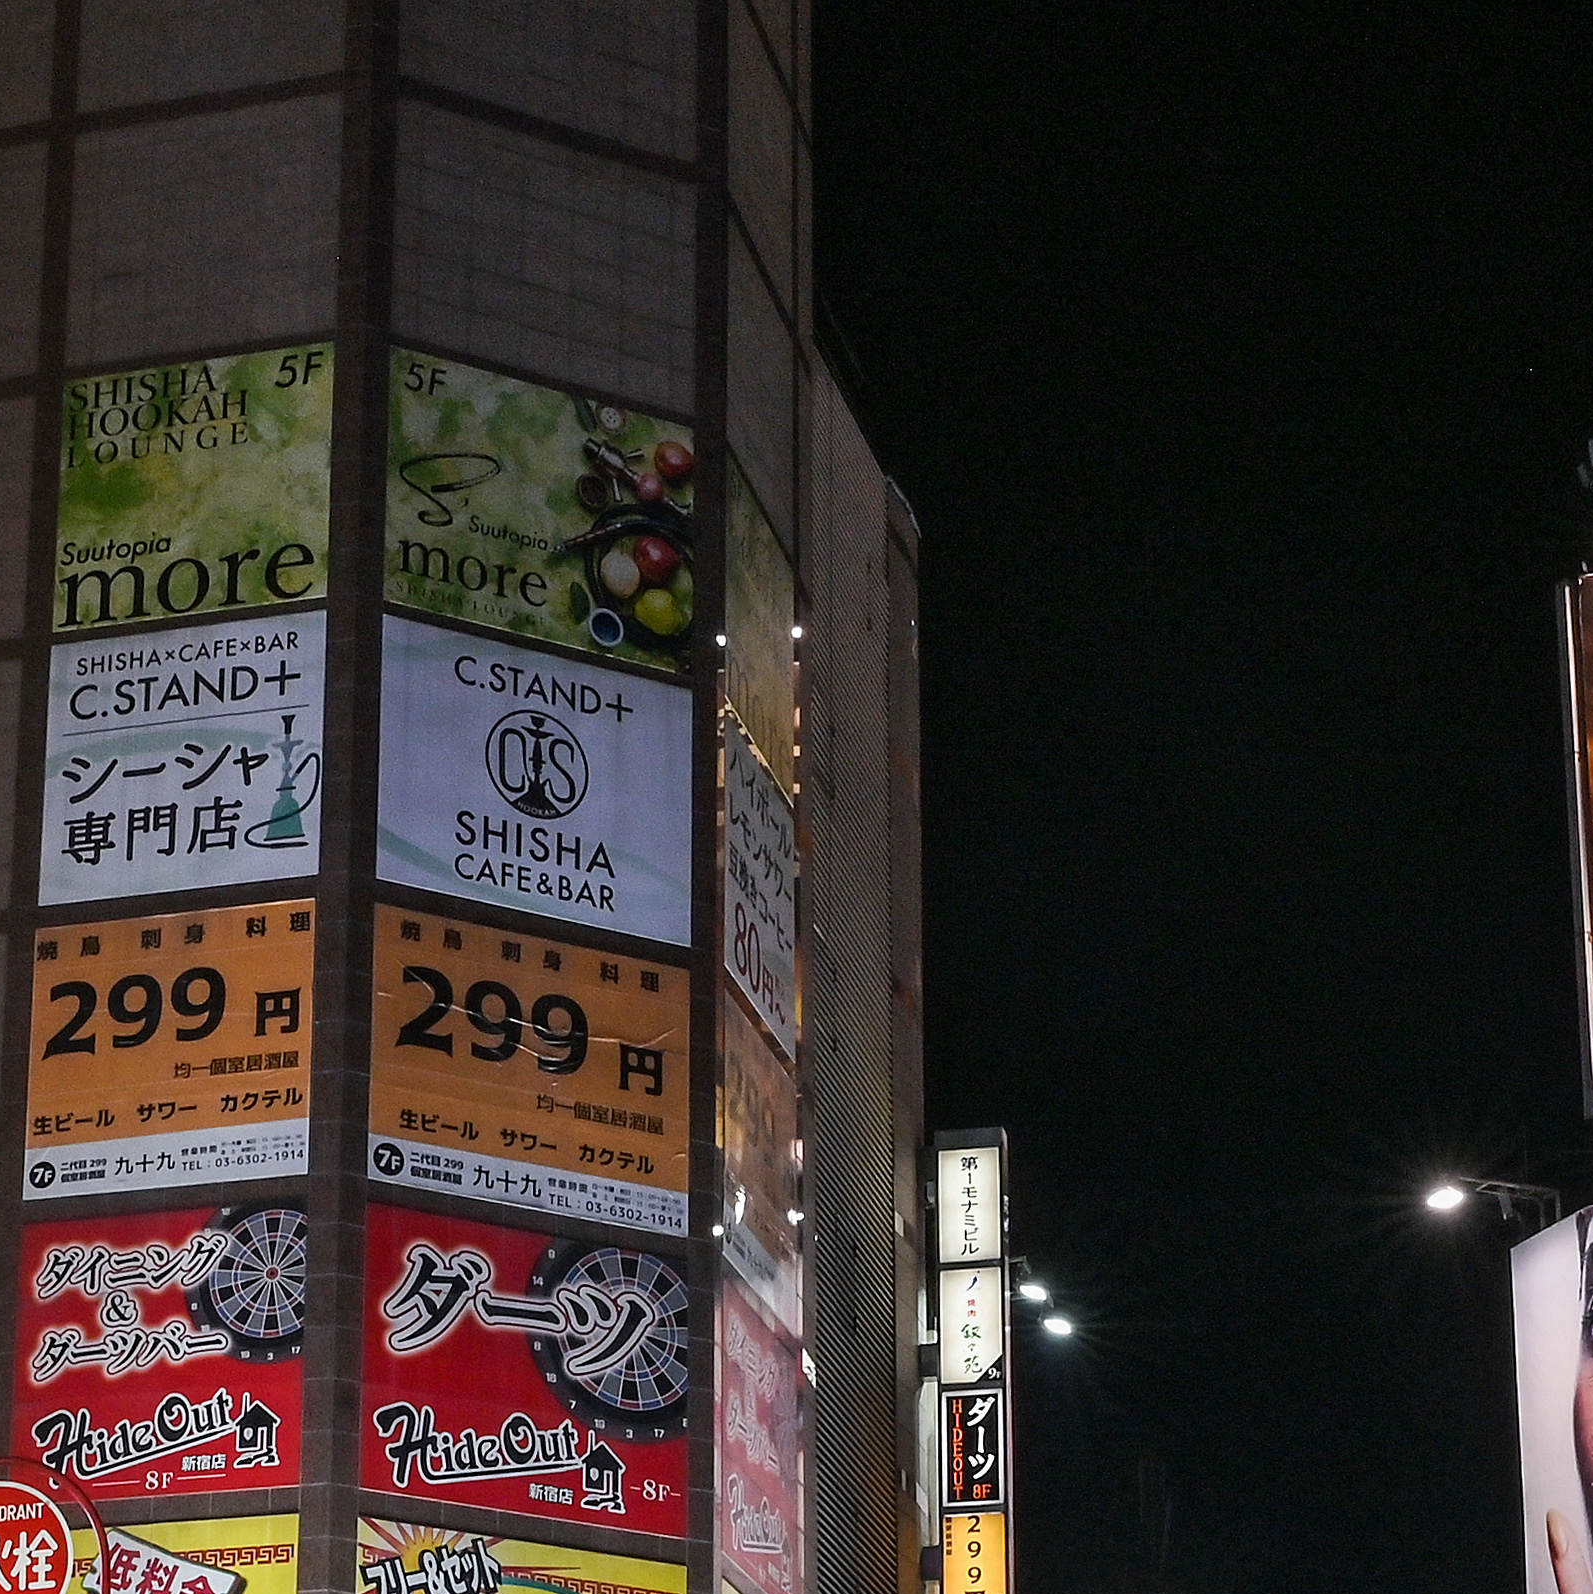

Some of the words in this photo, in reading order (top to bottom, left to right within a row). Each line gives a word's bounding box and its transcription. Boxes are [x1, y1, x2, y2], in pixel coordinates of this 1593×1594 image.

[66, 365, 217, 413] SHISHA
[274, 351, 326, 390] 5F
[404, 362, 448, 397] 5F
[66, 390, 249, 442] HOOKAH
[66, 422, 249, 469] LOUNGE
[60, 532, 173, 567] Suutopia
[468, 515, 549, 551] Suutopia
[56, 538, 316, 628] more
[397, 539, 548, 608] more
[61, 741, 269, 806] シーシャ
[61, 797, 243, 866] 専門店
[454, 809, 616, 881] SHISHA
[454, 852, 616, 913] CAFE&BAR
[33, 1107, 115, 1137] 生ビール
[137, 1101, 197, 1123] サワー
[220, 1087, 304, 1114] カクテル
[115, 1151, 176, 1177] 九十九
[215, 1149, 305, 1169] 03-6302-1914
[399, 1108, 480, 1142] 生ビール
[500, 1126, 559, 1154] サワー
[577, 1142, 654, 1176] カクテル
[472, 1164, 542, 1198] 九十九
[584, 1200, 684, 1230] 03-6302-1914
[35, 1233, 230, 1299] ダイニング
[104, 1292, 137, 1327] &
[382, 1243, 654, 1379] ダーツ
[32, 1325, 230, 1385] ダーツバー
[180, 1451, 228, 1471] 新宿店
[951, 1397, 964, 1501] HIDEOUT
[966, 1395, 997, 1481] ダーツ
[144, 1469, 175, 1491] 8F
[527, 1483, 575, 1507] 新宿店
[642, 1479, 670, 1501] 8F
[971, 1483, 994, 1500] 8F
